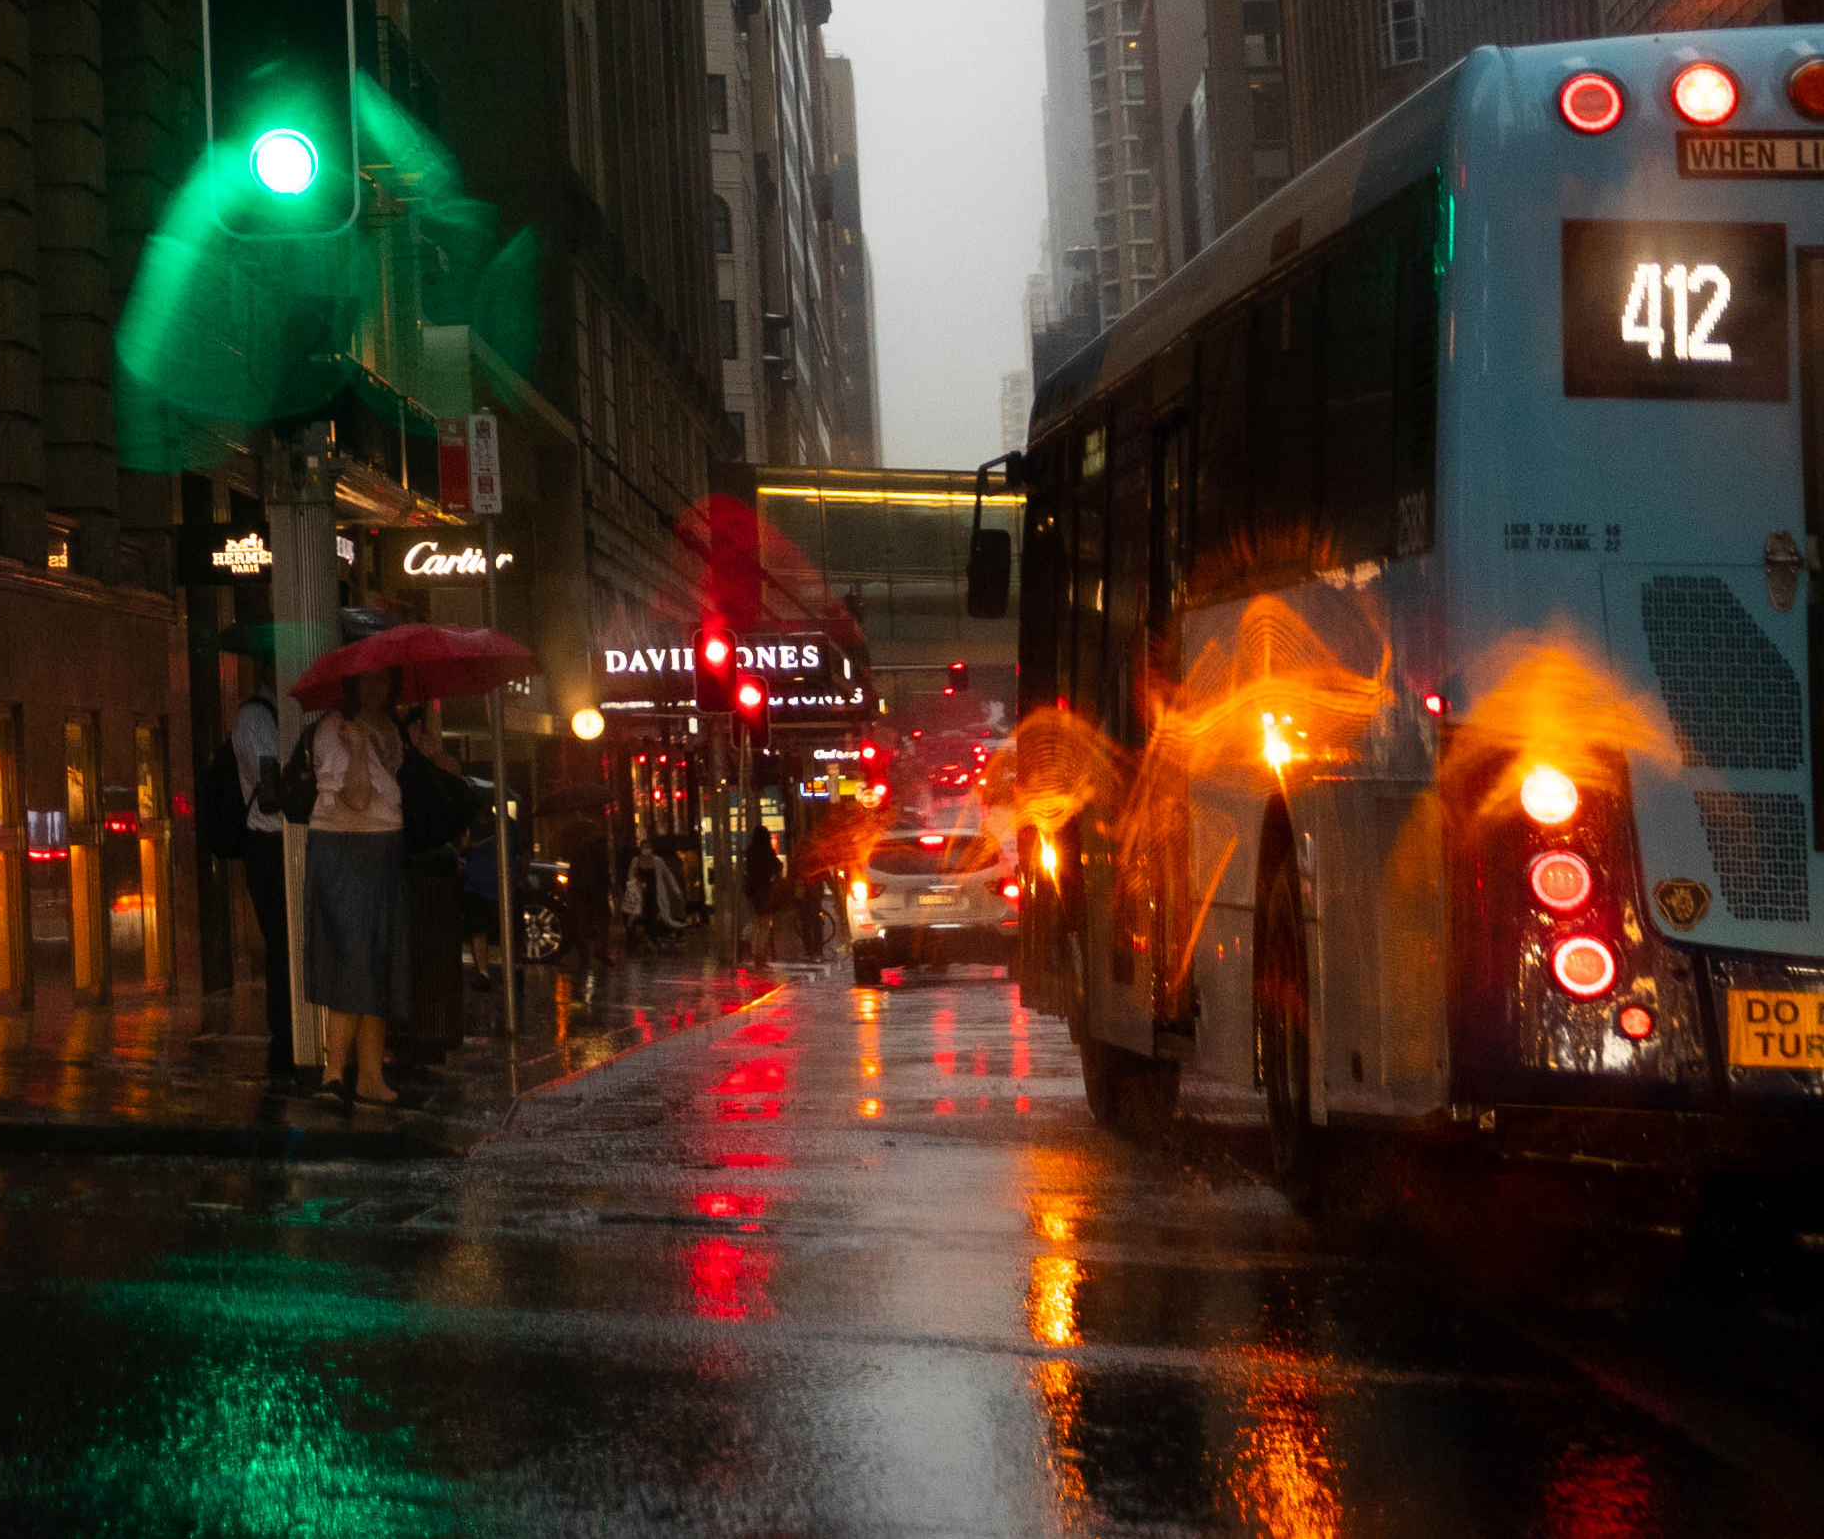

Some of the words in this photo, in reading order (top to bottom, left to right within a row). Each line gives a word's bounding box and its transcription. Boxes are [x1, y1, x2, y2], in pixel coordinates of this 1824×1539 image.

[1689, 141, 1776, 169] WHEN
[1797, 141, 1824, 169] LI
[1622, 263, 1732, 362] 412
[231, 564, 260, 574] PARIS
[1746, 999, 1800, 1024] DO
